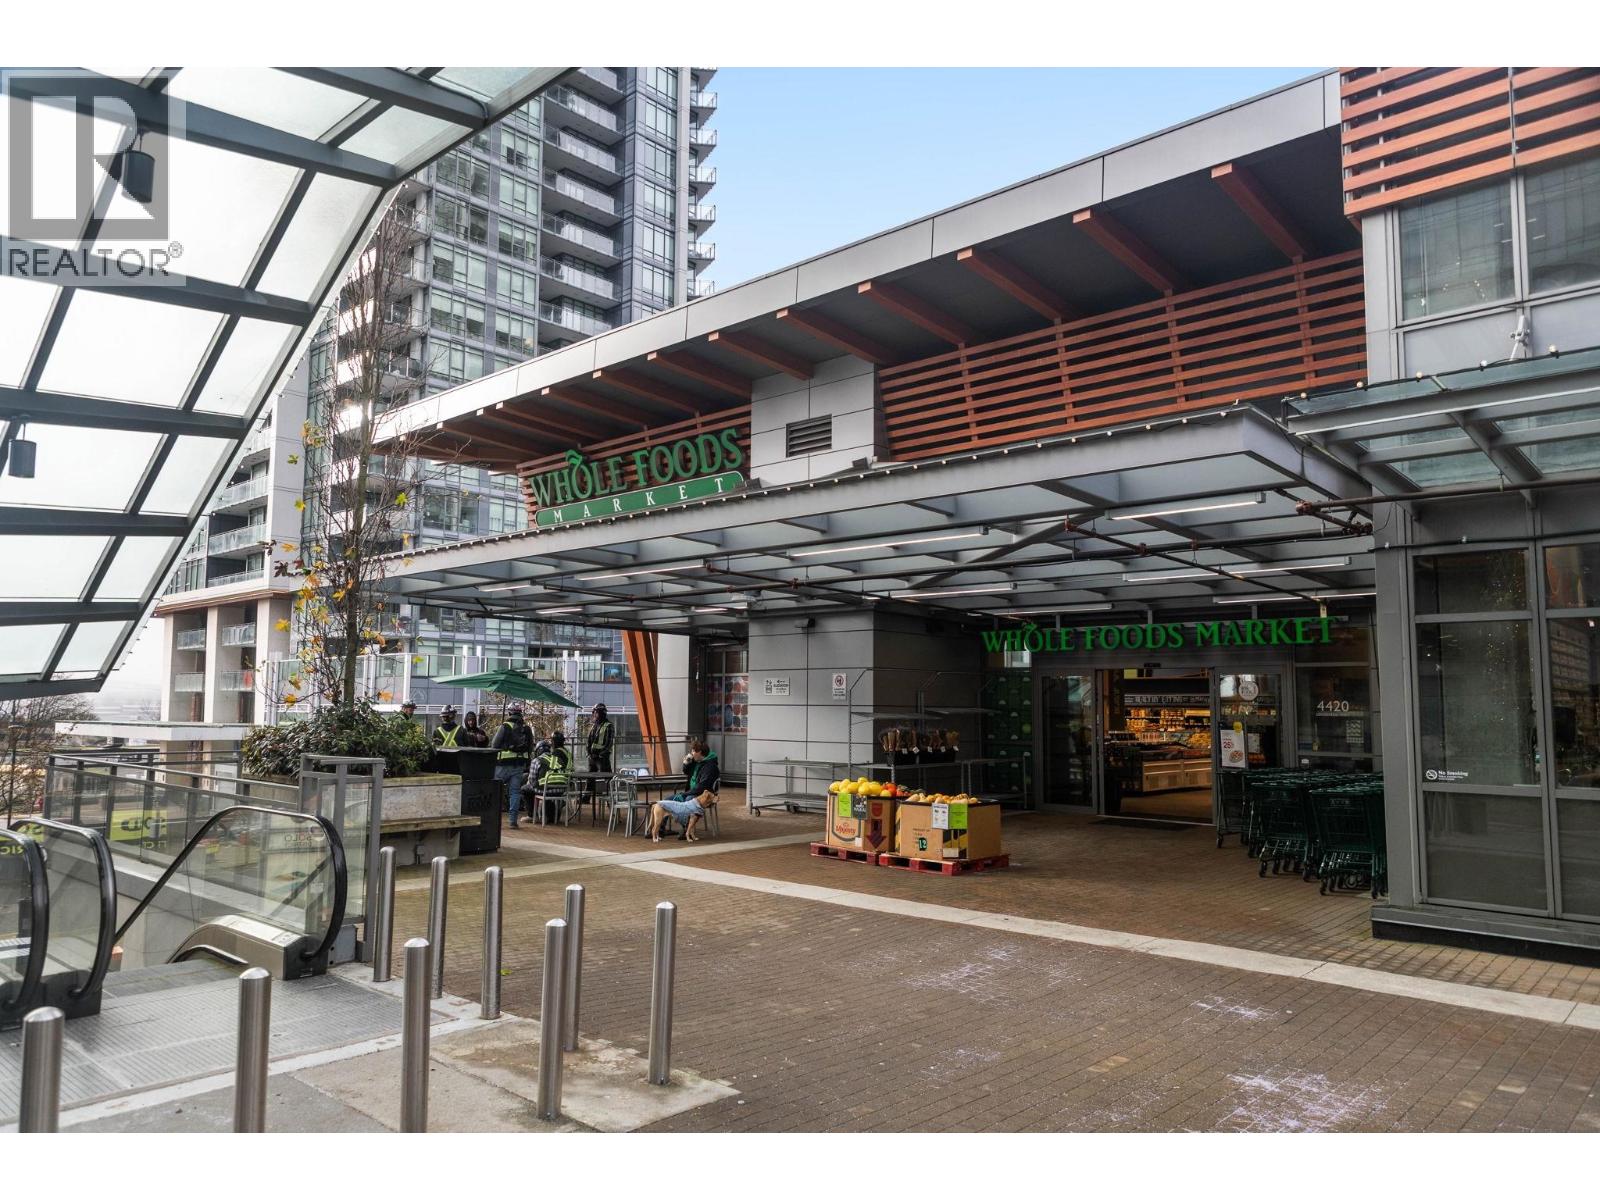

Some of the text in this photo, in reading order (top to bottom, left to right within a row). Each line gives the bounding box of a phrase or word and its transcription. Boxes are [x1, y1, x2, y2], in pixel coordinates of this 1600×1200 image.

[528, 428, 743, 507] WHOLE FOODS
[554, 478, 724, 522] MARKET
[981, 616, 1336, 652] WHOLE FOODS MARKET
[1317, 700, 1349, 712] 4420
